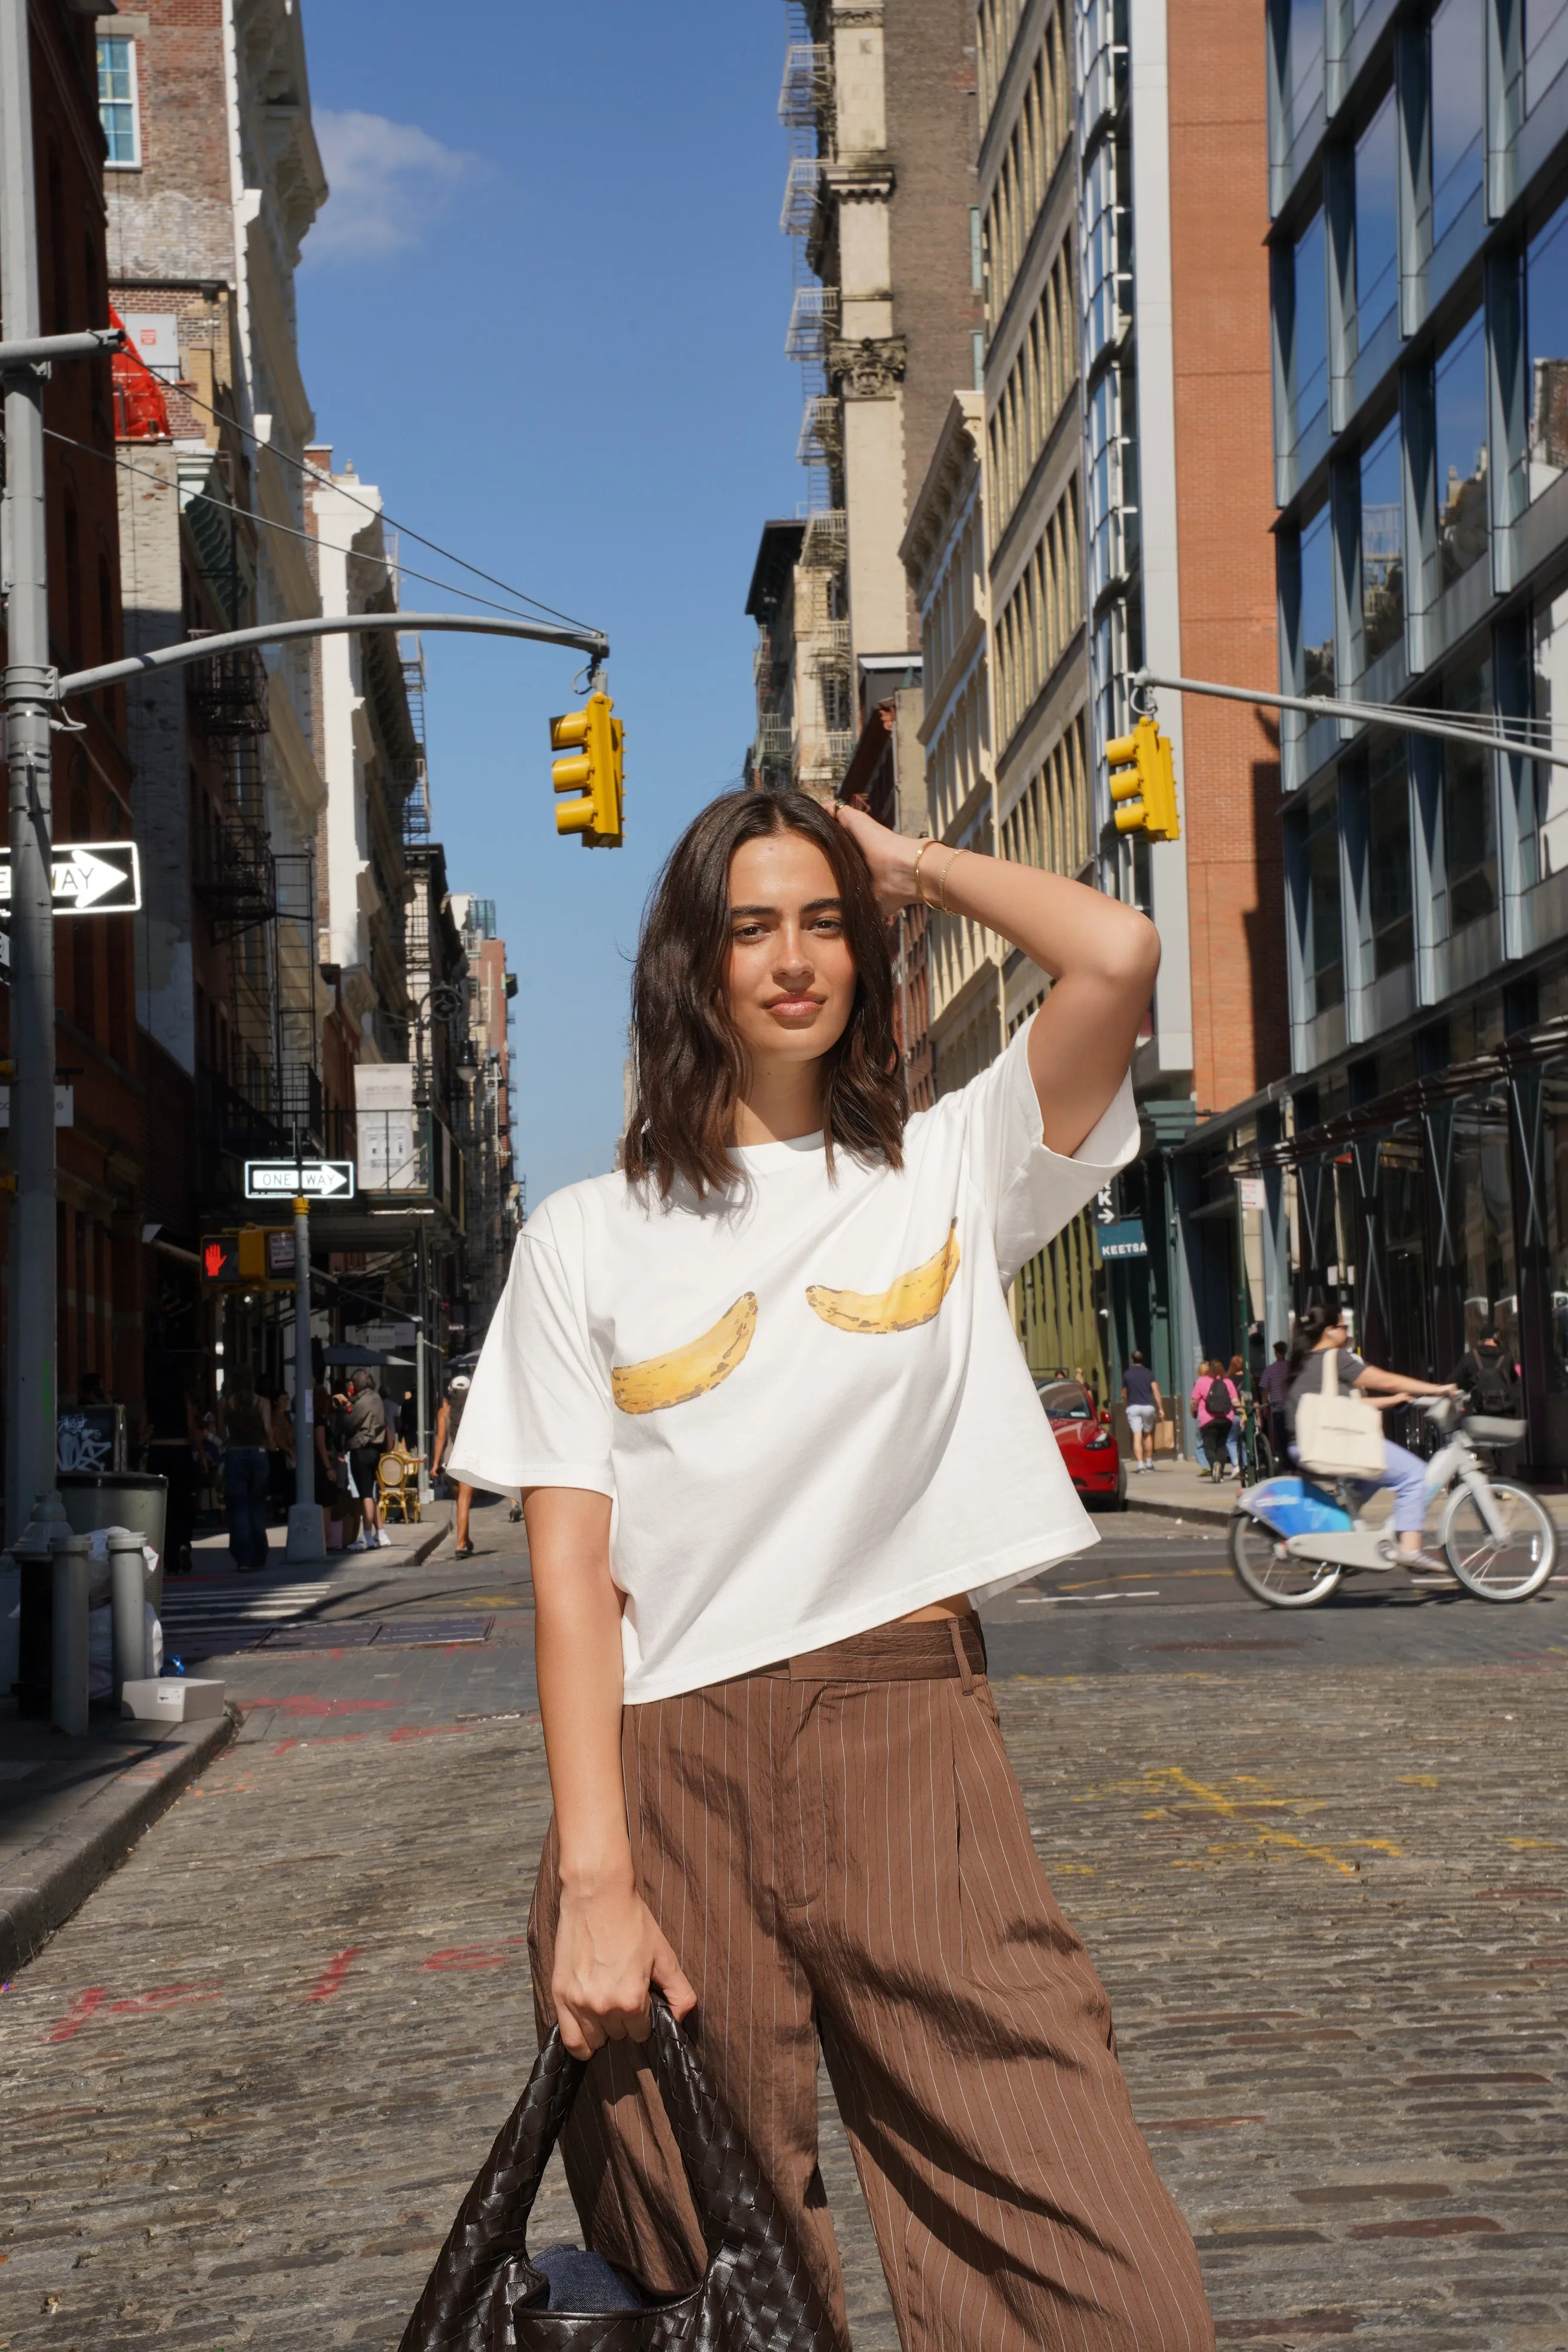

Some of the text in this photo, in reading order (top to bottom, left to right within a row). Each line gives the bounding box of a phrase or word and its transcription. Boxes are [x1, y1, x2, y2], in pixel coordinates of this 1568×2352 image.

[52, 868, 94, 890] AY
[263, 1174, 335, 1186] ONE WAY
[1101, 1242, 1148, 1255] KEETSA
